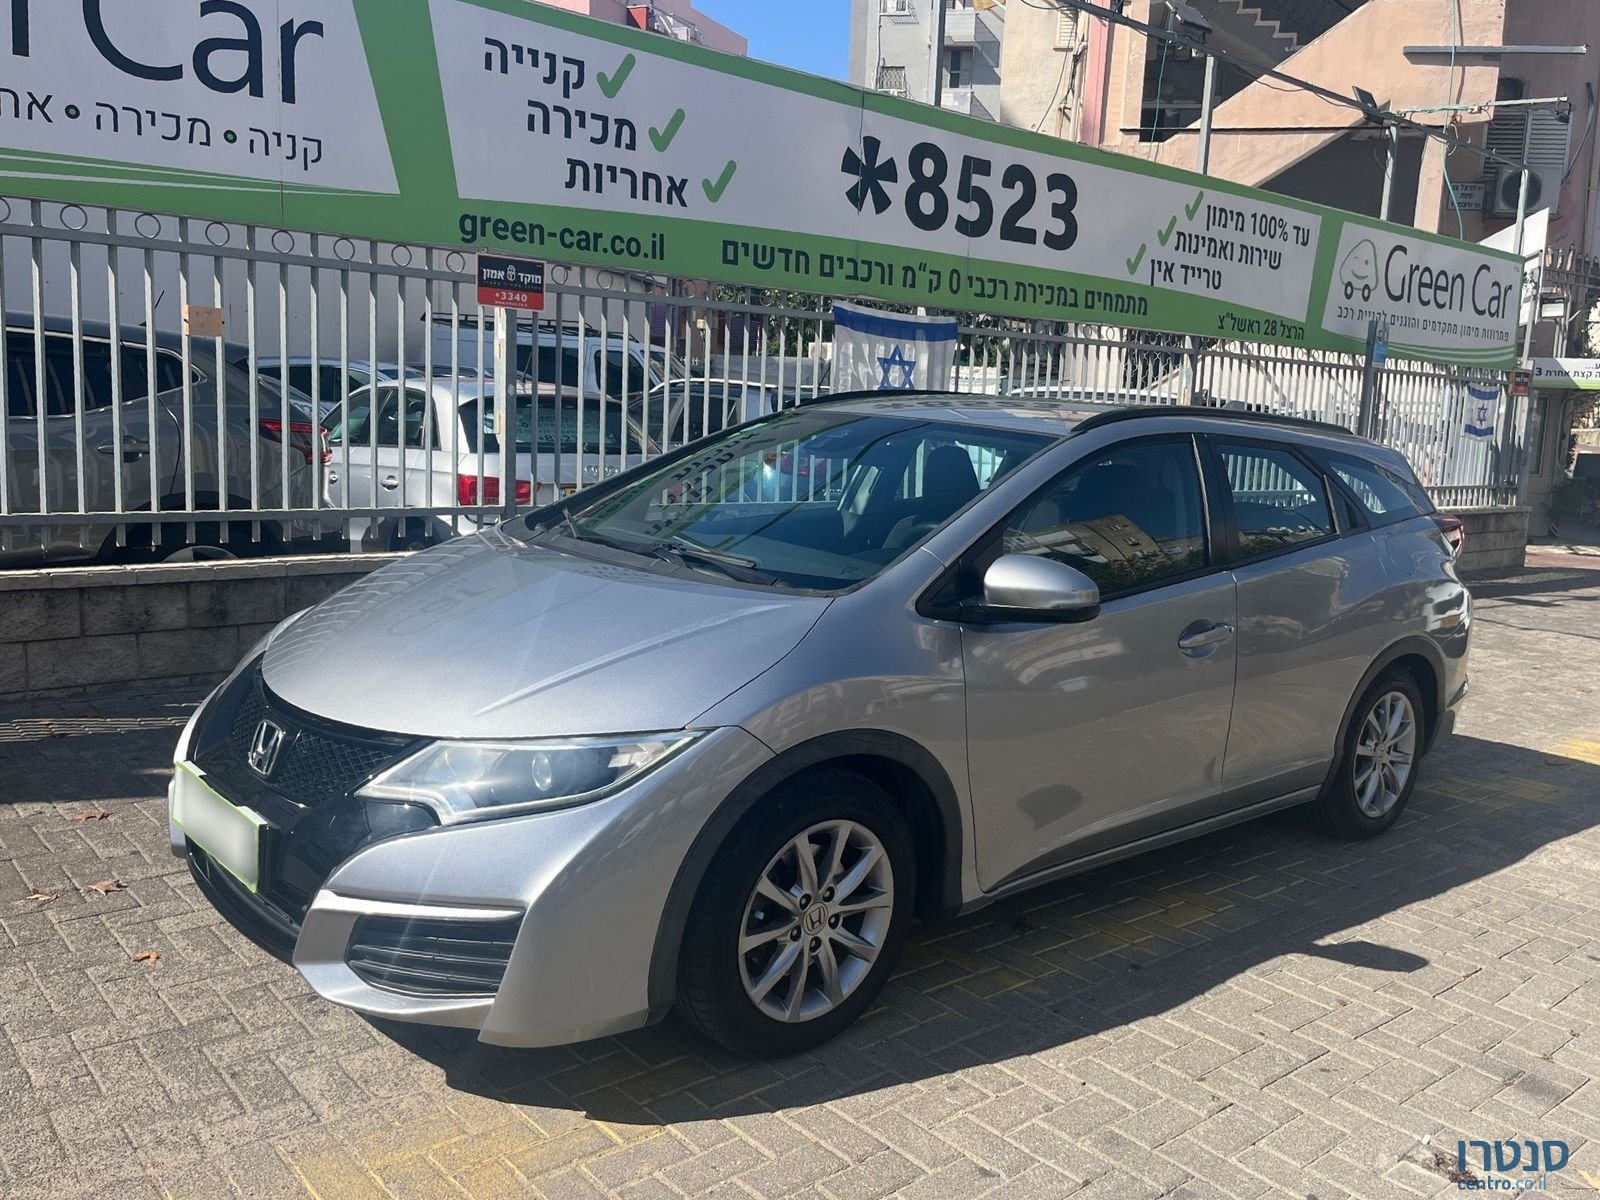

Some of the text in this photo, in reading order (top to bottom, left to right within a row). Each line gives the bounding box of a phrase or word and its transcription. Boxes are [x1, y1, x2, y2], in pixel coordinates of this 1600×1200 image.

[484, 37, 585, 98] קנייה
[96, 101, 210, 146] מכירה
[527, 99, 636, 151] מכירה
[249, 127, 322, 170] קניה
[565, 157, 688, 207] אחריות
[459, 213, 664, 260] green-car.co.il
[1206, 204, 1310, 247] עד 100% מימון
[722, 239, 810, 274] חדשים
[1174, 231, 1282, 270] שירות ואמינות
[482, 268, 541, 285] מוקד אמון
[819, 253, 893, 286] ורכבים
[949, 268, 961, 295] 0
[1150, 258, 1222, 290] טרייד אין
[1384, 244, 1512, 319] Green Car
[967, 275, 1008, 300] רכבי
[1014, 281, 1079, 308] במכירת
[1084, 289, 1148, 316] מתמחים
[1263, 319, 1277, 337] 28
[1337, 306, 1354, 319] רכב
[1280, 321, 1305, 341] הרצל
[1573, 370, 1592, 379] קצת
